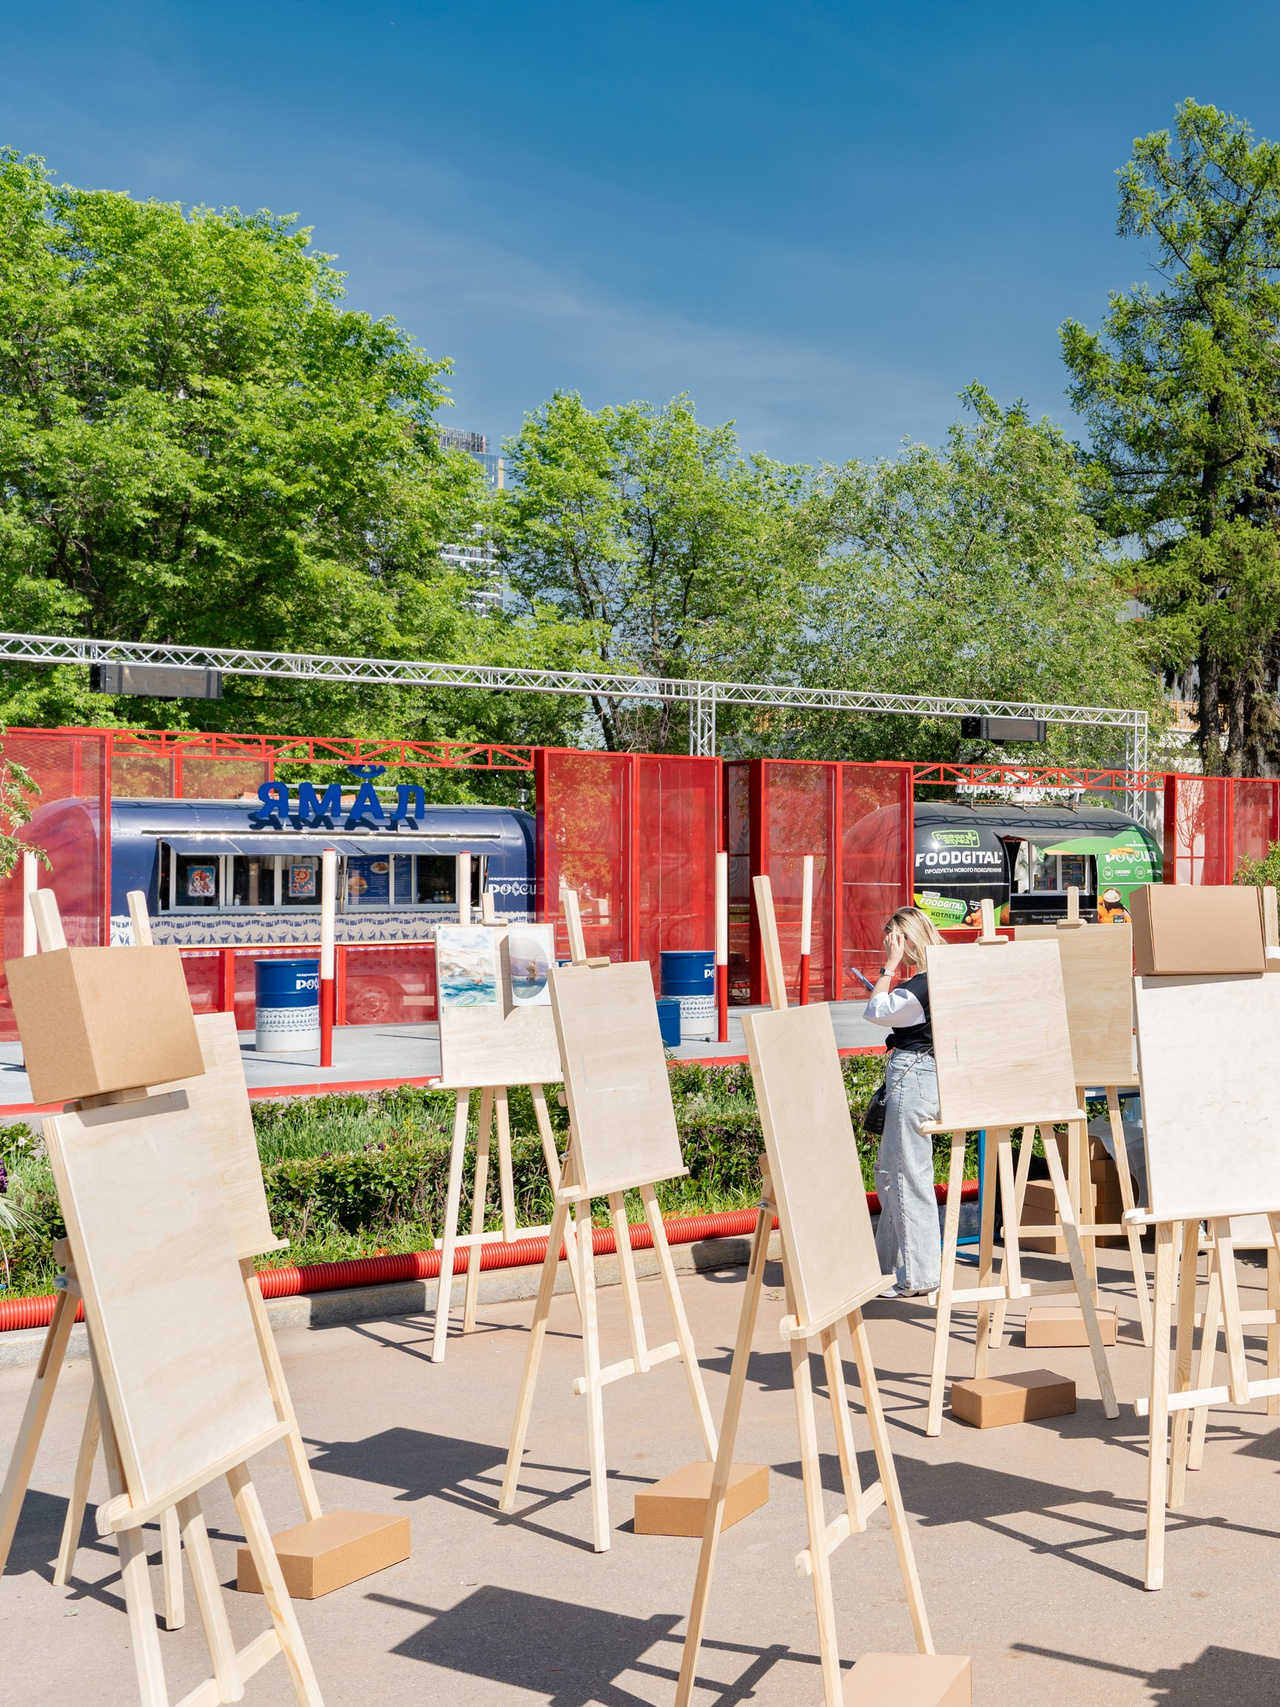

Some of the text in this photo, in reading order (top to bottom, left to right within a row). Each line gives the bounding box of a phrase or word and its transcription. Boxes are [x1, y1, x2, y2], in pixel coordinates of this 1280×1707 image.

[255, 781, 425, 820] ЯМАЛ
[915, 851, 1002, 867] FOODGITAL
[925, 867, 954, 875] ПРОДУКТЫ
[920, 897, 964, 910] FOODGITAL
[930, 911, 961, 920] КОТЛЕТЫ
